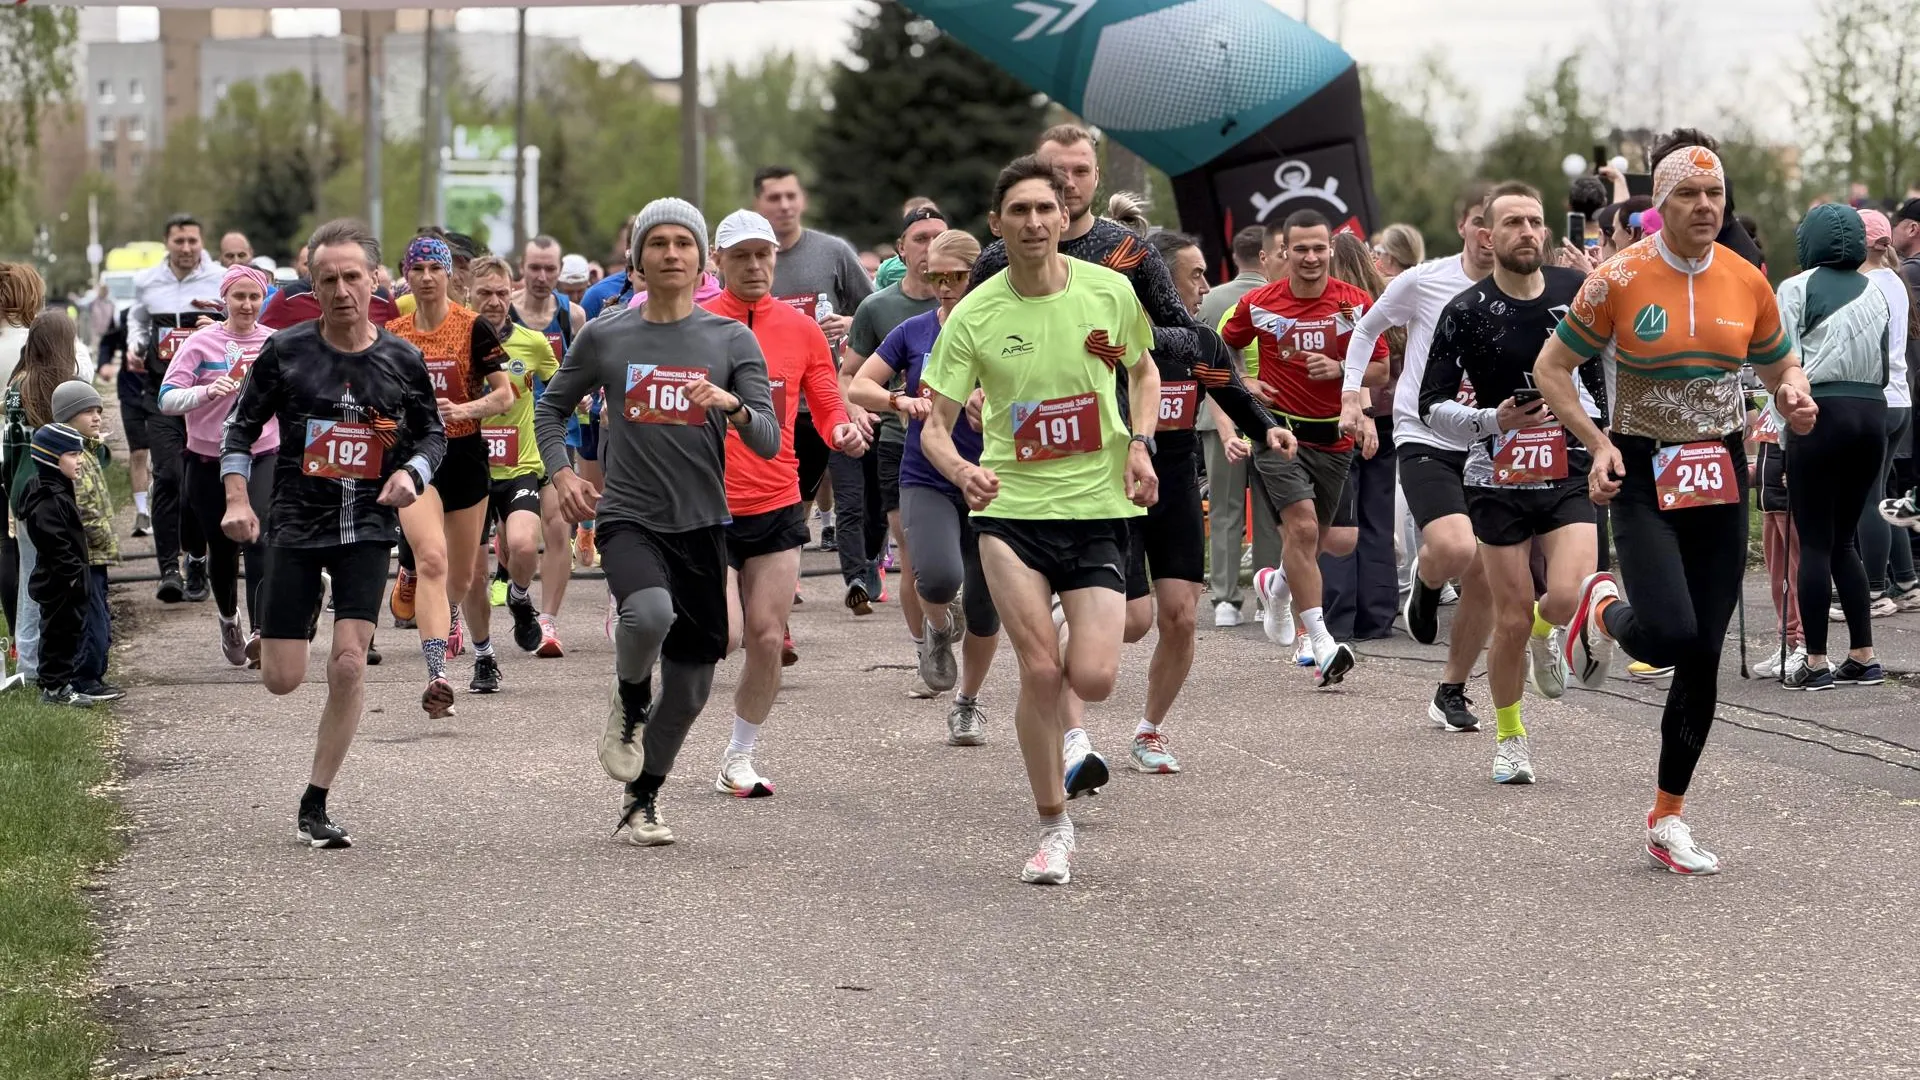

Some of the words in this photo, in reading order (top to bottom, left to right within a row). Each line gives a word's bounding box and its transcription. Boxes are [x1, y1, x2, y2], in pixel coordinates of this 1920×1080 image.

[1001, 342, 1034, 356] ARC
[1292, 331, 1325, 351] 189
[1035, 415, 1080, 446] 191
[325, 439, 368, 466] 192
[1511, 444, 1553, 470] 276
[1676, 461, 1723, 493] 243
